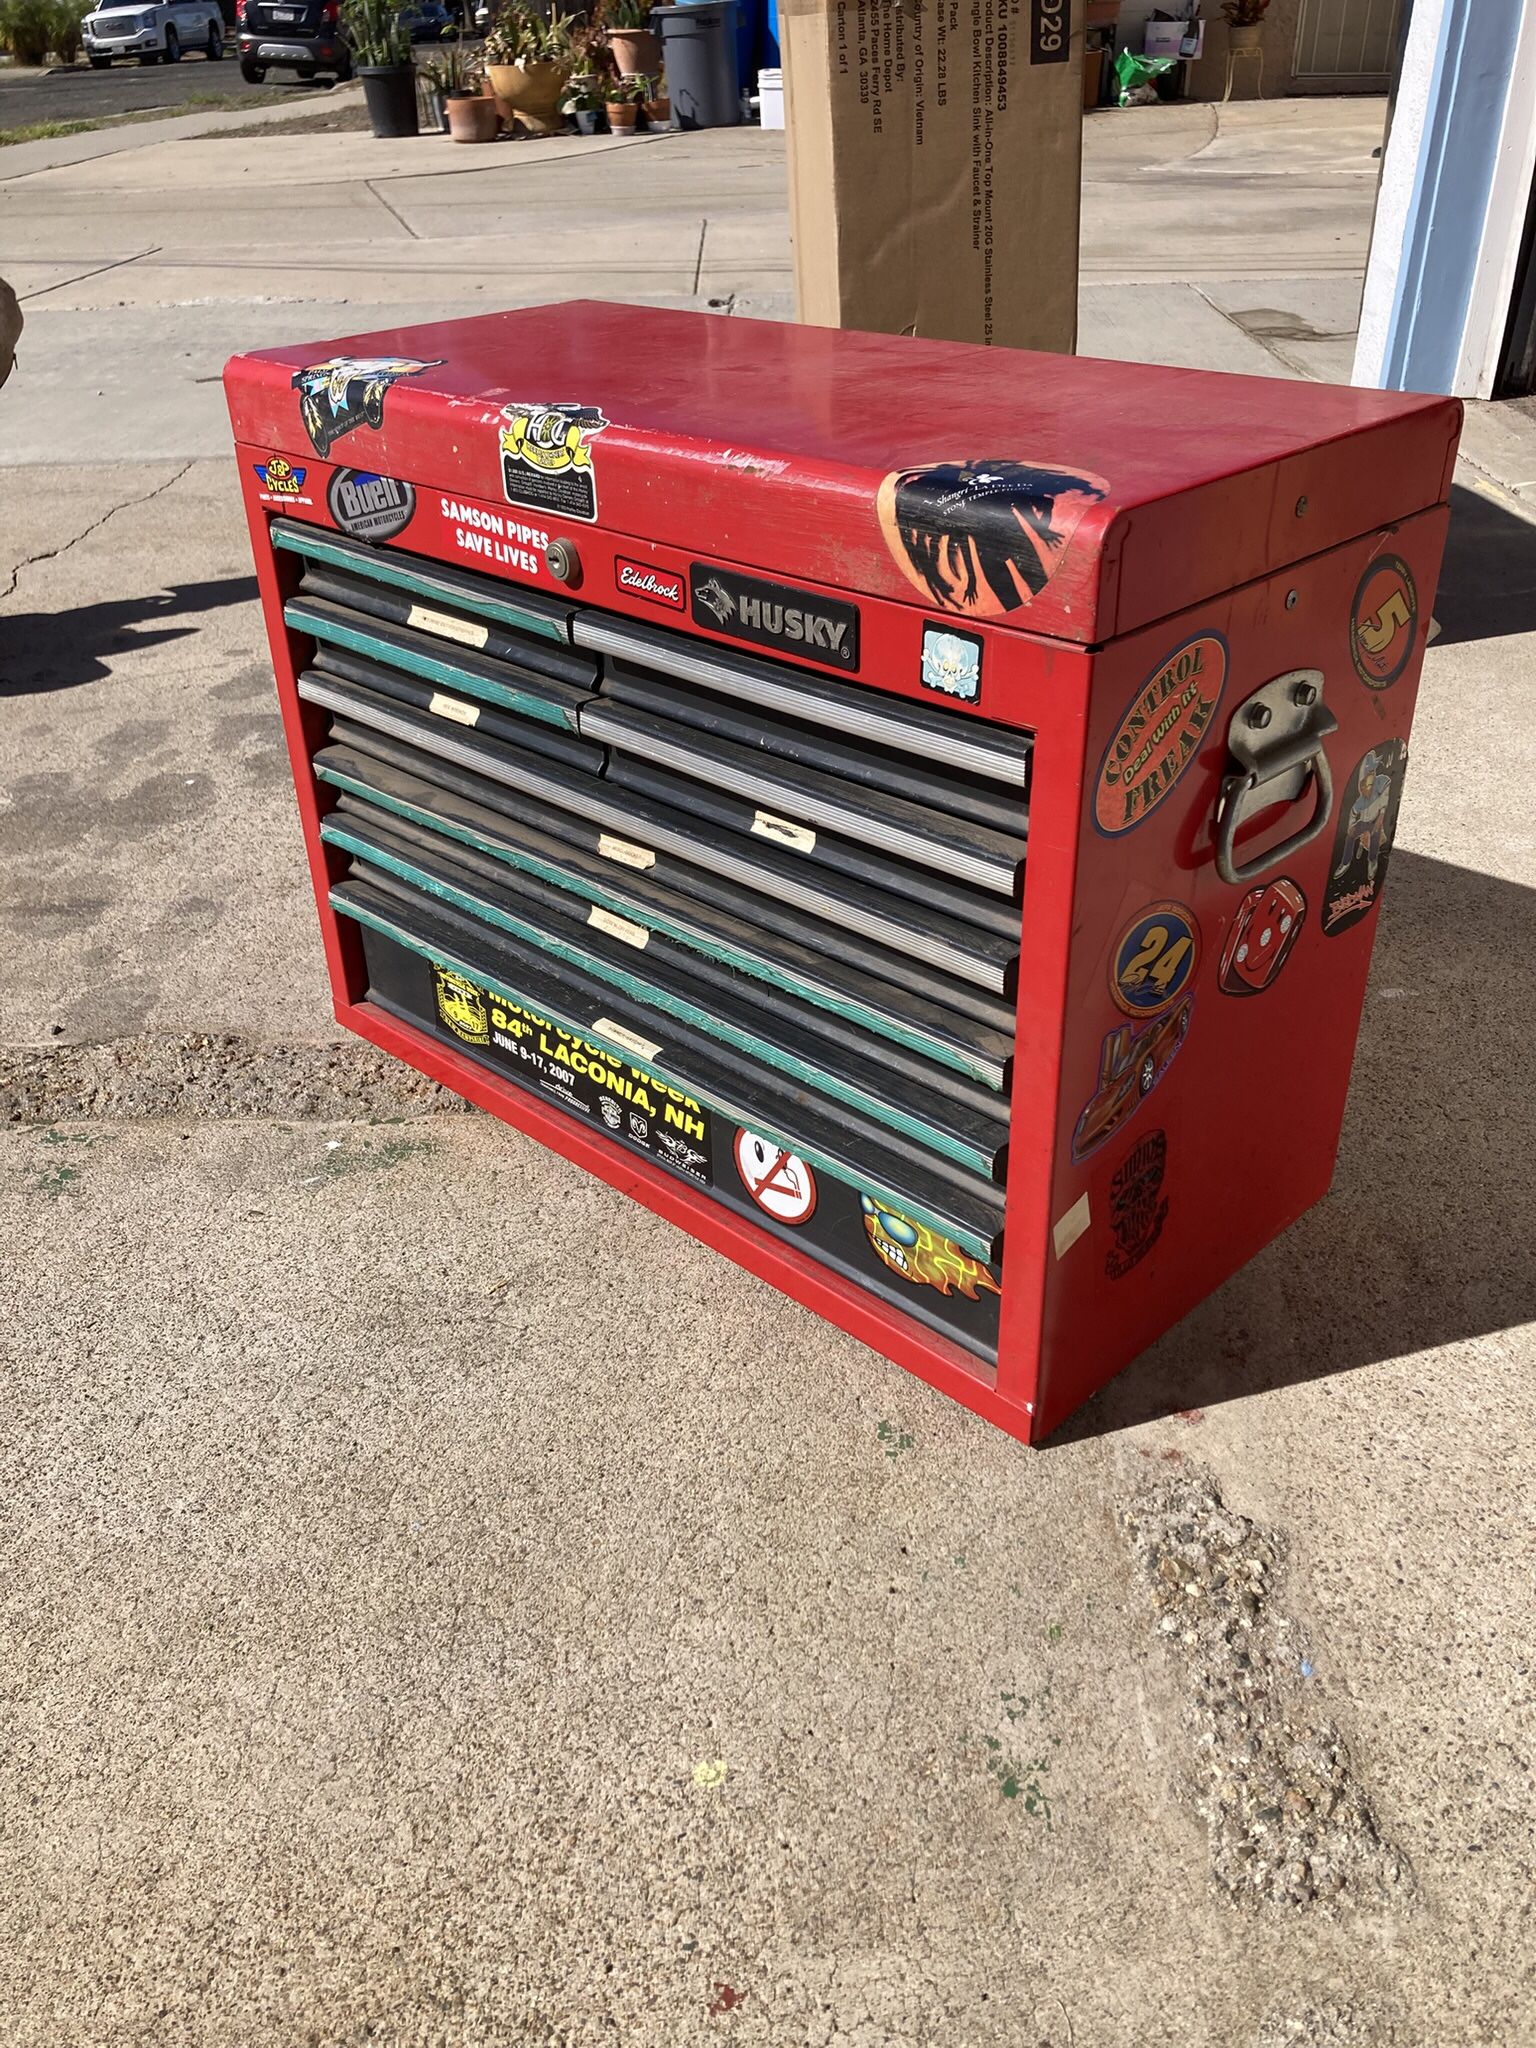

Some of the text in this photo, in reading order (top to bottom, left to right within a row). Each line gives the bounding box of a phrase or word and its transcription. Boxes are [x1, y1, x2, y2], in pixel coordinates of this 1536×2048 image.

[837, 1, 847, 41] Carton
[950, 2, 958, 31] Pack
[857, 0, 869, 104] Atlanta, GA 30339
[871, 29, 881, 64] Paces
[883, 23, 892, 56] Home
[915, 44, 924, 56] of
[937, 0, 947, 106] ase Wt: 22.28 LBS
[972, 29, 981, 58] Bowl
[839, 53, 849, 66] of
[883, 59, 893, 93] Depot
[895, 63, 905, 82] By:
[983, 37, 994, 105] Description:
[997, 24, 1008, 111] 1008849453
[871, 67, 881, 96] Ferry
[913, 58, 924, 97] Origin:
[972, 61, 981, 104] Kitchen
[873, 100, 882, 115] Rd
[915, 100, 925, 145] Vietnam
[972, 107, 981, 131] Sink
[873, 118, 882, 133] SE
[984, 109, 993, 163] All-in-One
[972, 134, 981, 157] with
[972, 160, 981, 196] Faucet
[983, 166, 993, 187] Top
[972, 199, 981, 207] &
[984, 190, 993, 222] Mount
[972, 210, 981, 250] Strainer
[984, 225, 993, 245] 20G
[984, 248, 993, 294] Stainless
[984, 297, 993, 321] Steel
[984, 323, 993, 335] 25
[265, 473, 300, 493] CYCLES
[268, 459, 291, 477] J&P
[340, 477, 401, 517] Buell
[968, 489, 1000, 502] TEMPLE
[351, 511, 406, 532] AMERICAN MOTORCYCLES
[441, 498, 549, 551] SAMSON PIPES
[456, 528, 538, 574] SAVE LIVES
[620, 567, 678, 601] Edelbrock
[739, 595, 848, 652] HUSKY
[1105, 646, 1204, 785] CONTROL
[1123, 693, 1214, 824] FREAK
[1124, 744, 1153, 785] Deal
[1152, 705, 1181, 744] With
[1119, 926, 1194, 996] 24
[491, 1008, 533, 1038] 84th
[540, 1033, 656, 1117] LACONIA,
[664, 1103, 705, 1141] NH
[492, 1031, 575, 1086] JUNE 9-17, 2007
[658, 1149, 707, 1180] BUDWEISER
